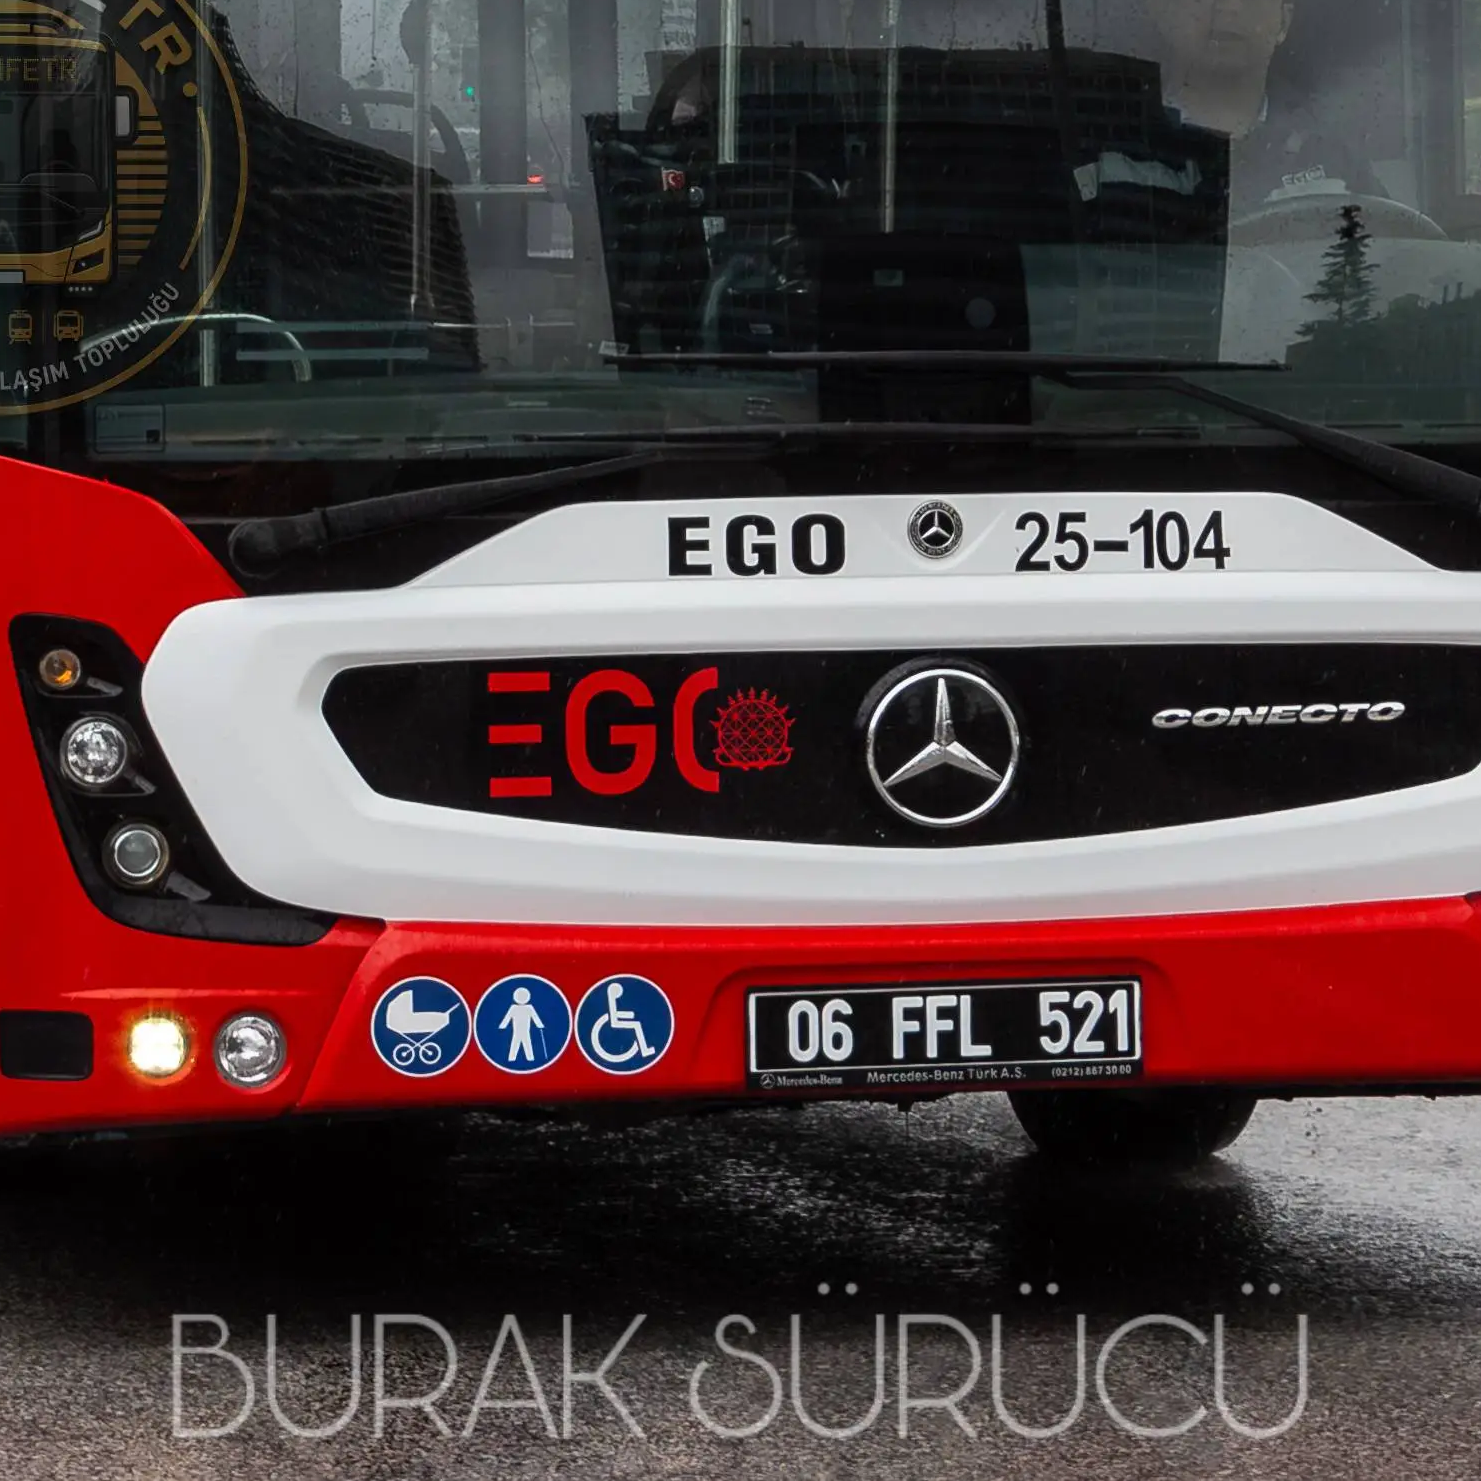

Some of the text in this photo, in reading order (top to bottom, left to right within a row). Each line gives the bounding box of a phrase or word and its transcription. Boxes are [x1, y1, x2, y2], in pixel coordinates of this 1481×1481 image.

[668, 513, 846, 577] EGO
[1014, 508, 1232, 572] 25-104
[488, 666, 719, 798] EGO
[1151, 701, 1406, 729] CONECTO
[788, 989, 1129, 1063] 06 FFL 521
[866, 1069, 965, 1084] Mercedes-Benz
